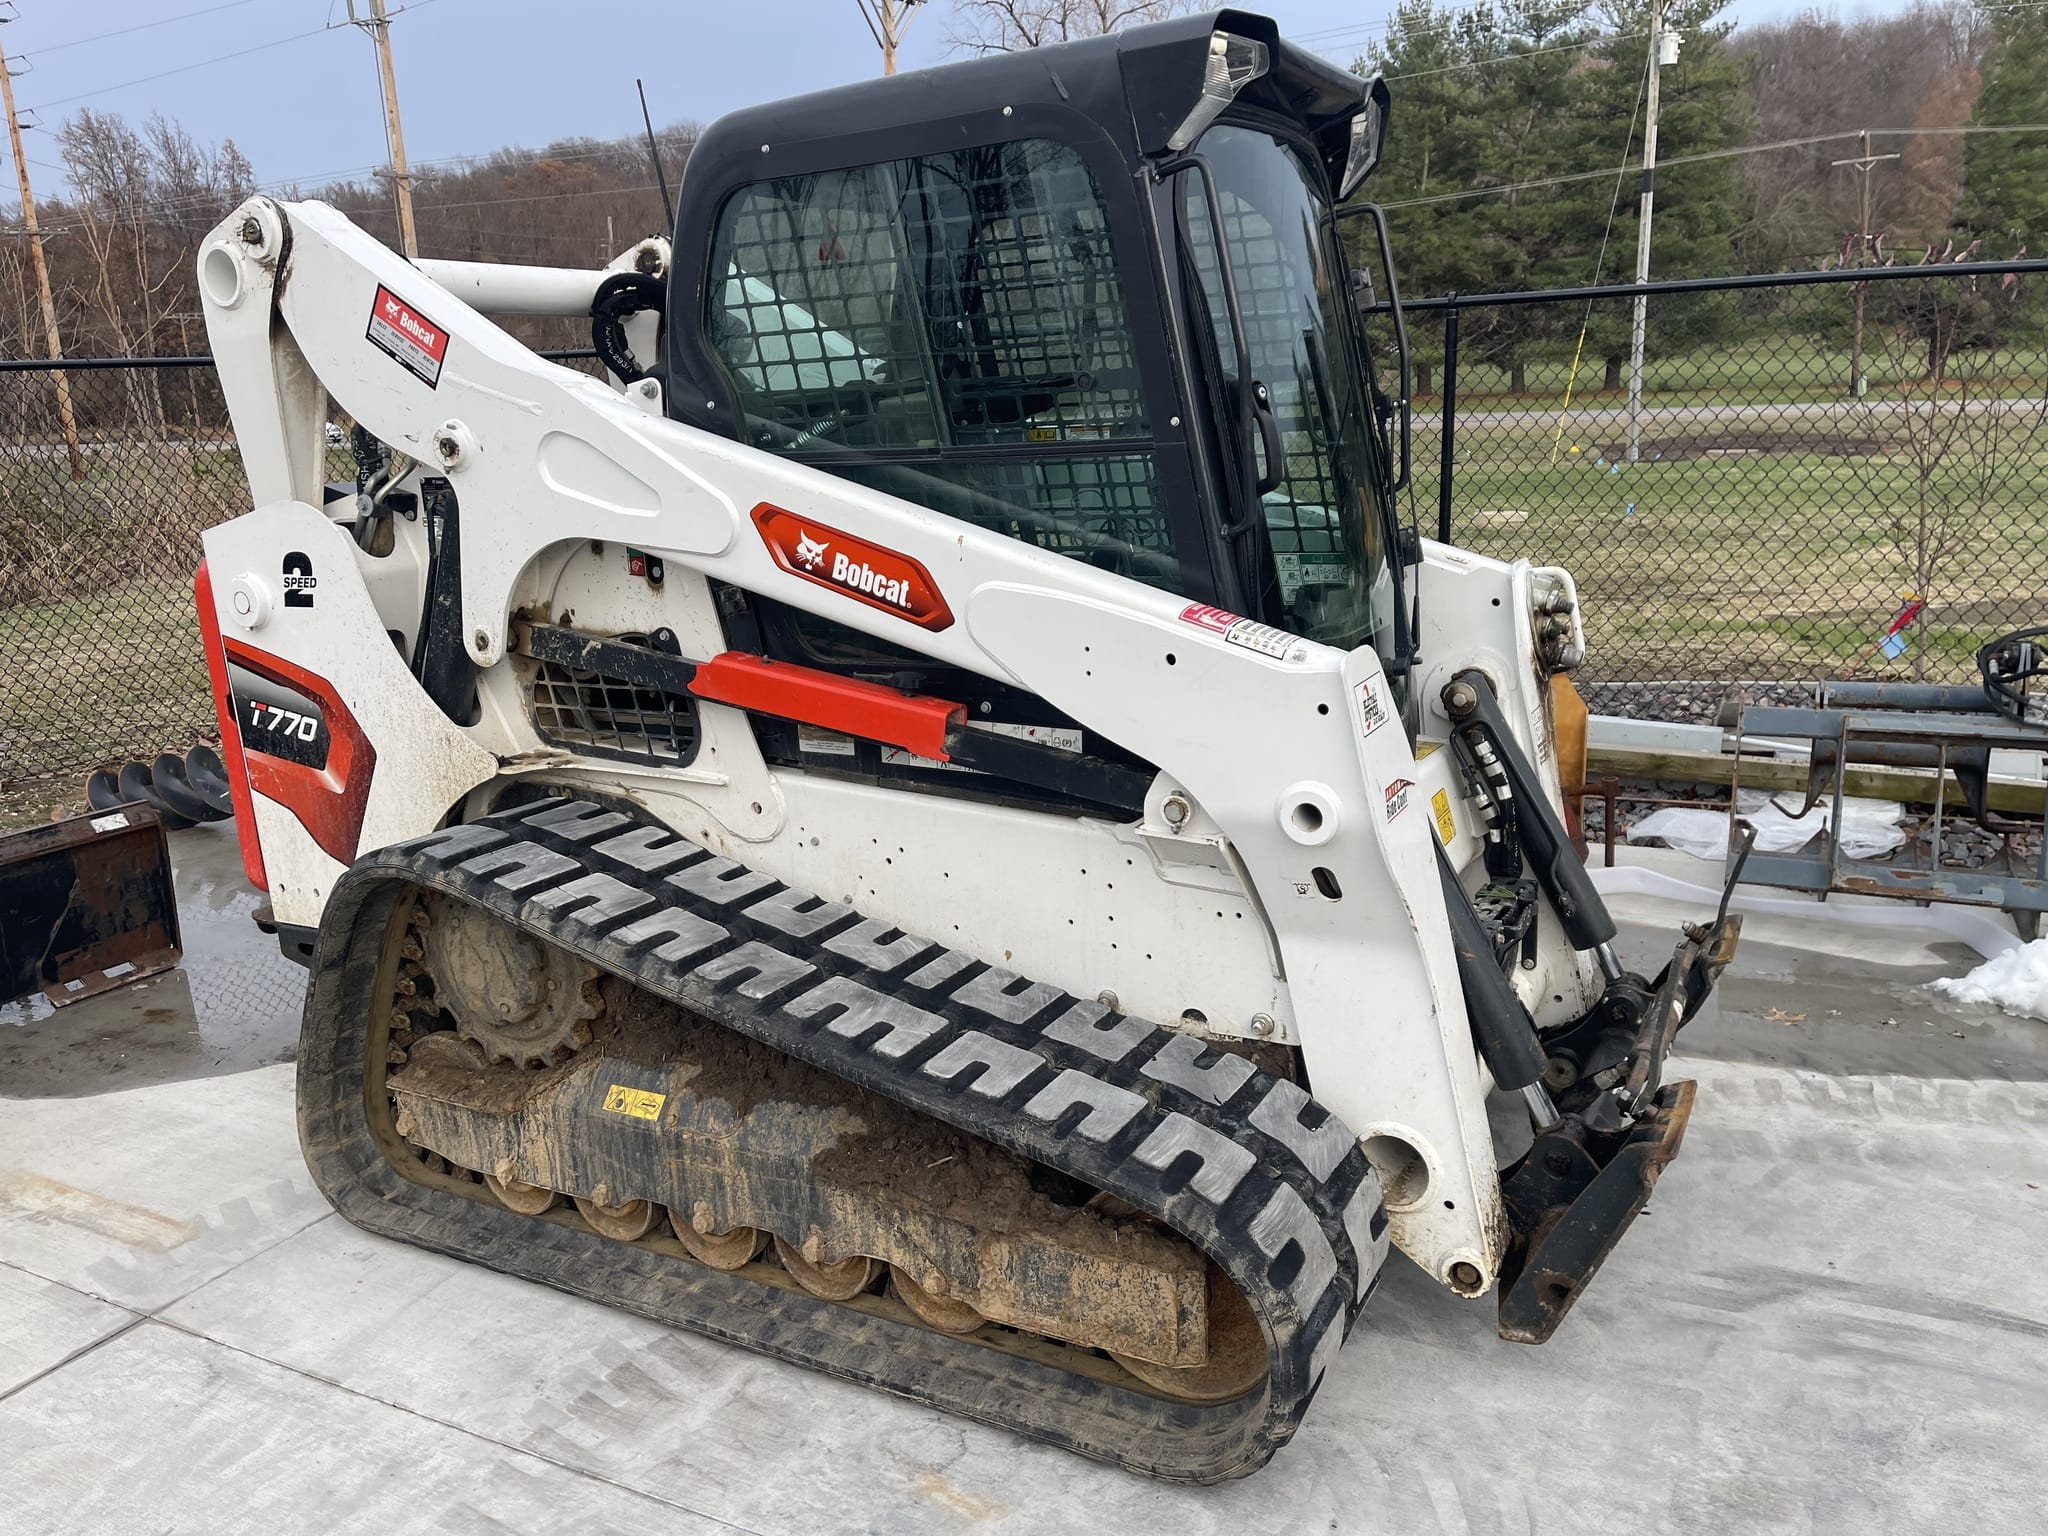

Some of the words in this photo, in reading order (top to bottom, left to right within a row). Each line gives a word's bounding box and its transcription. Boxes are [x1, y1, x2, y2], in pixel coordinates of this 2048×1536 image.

[400, 310, 435, 348] Bobcat
[283, 577, 317, 588] SPEED
[832, 552, 909, 607] Bobcat
[250, 701, 318, 742] T770
